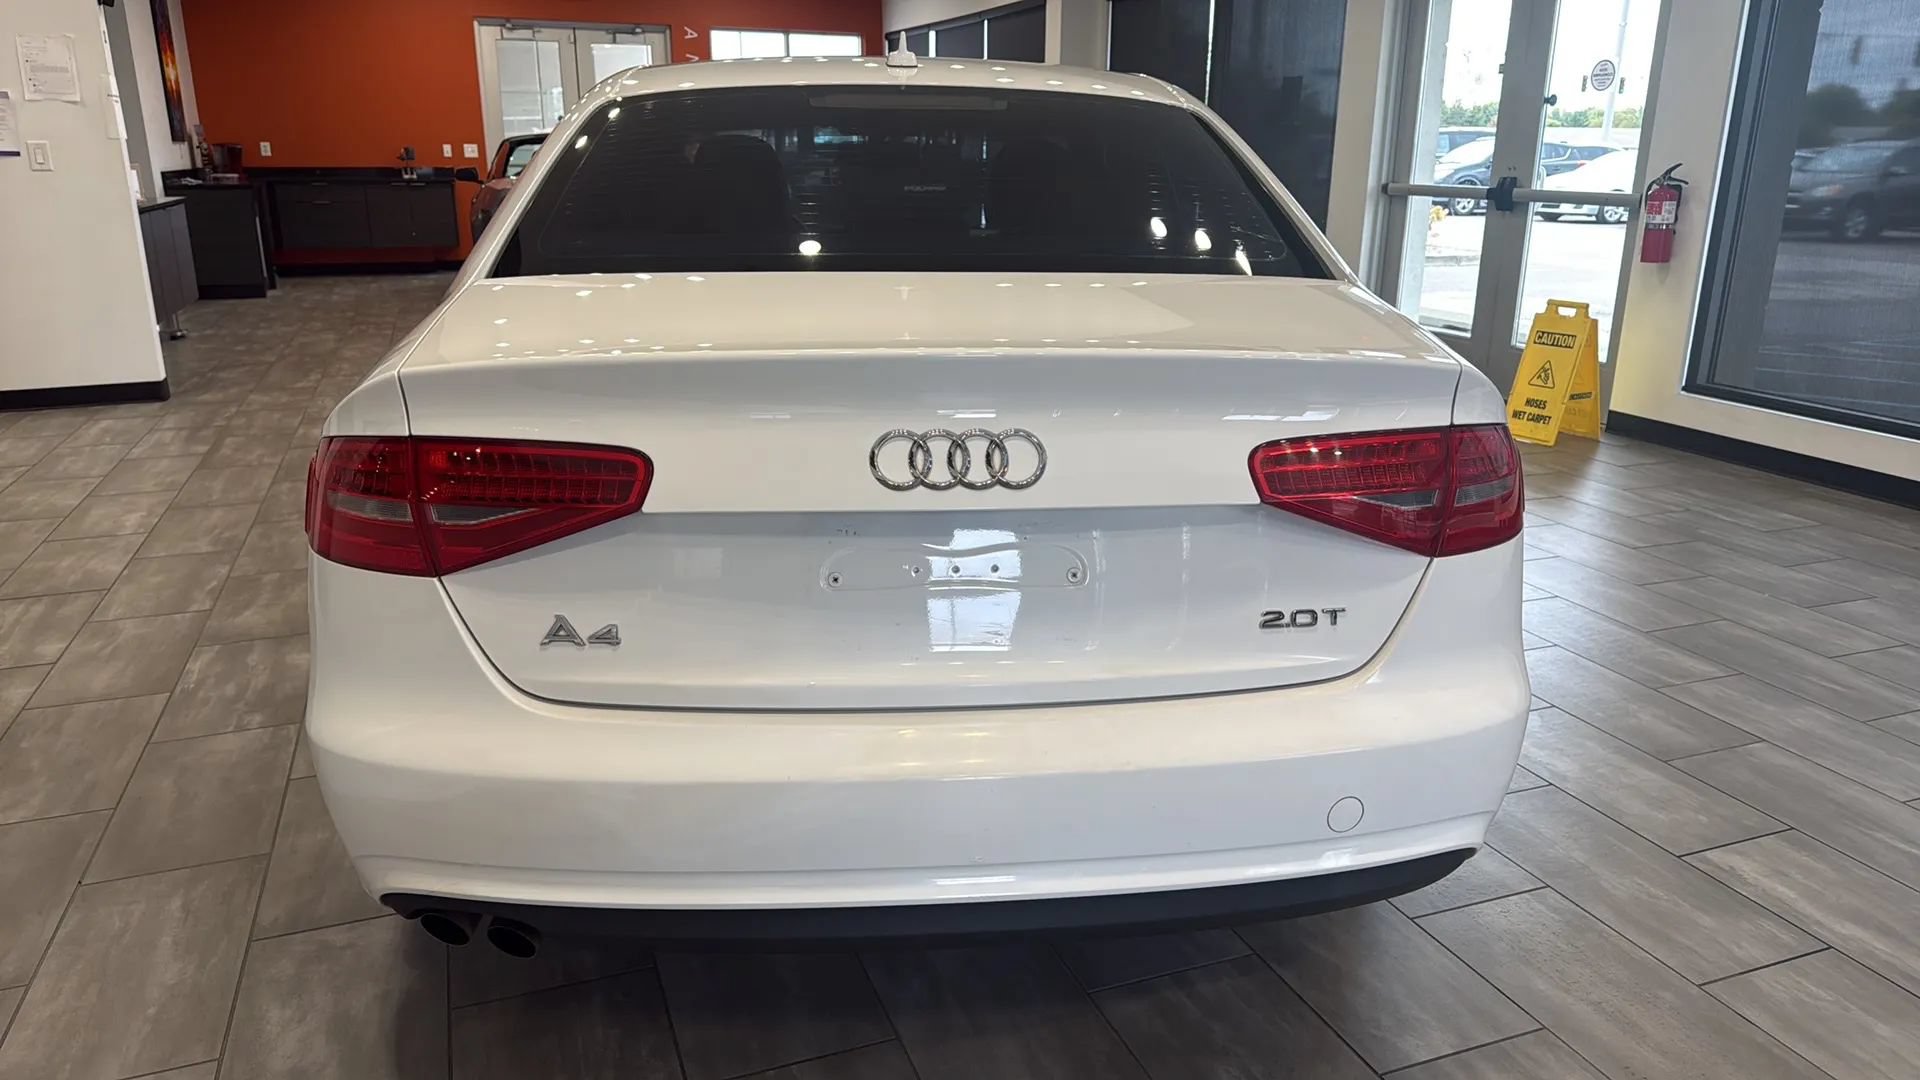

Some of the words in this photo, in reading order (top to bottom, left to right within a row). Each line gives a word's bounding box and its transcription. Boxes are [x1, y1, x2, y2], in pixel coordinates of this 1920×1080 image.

[1535, 331, 1576, 348] CAUTION
[1512, 409, 1526, 421] WET
[1526, 412, 1552, 425] CARPET
[540, 614, 621, 646] A4
